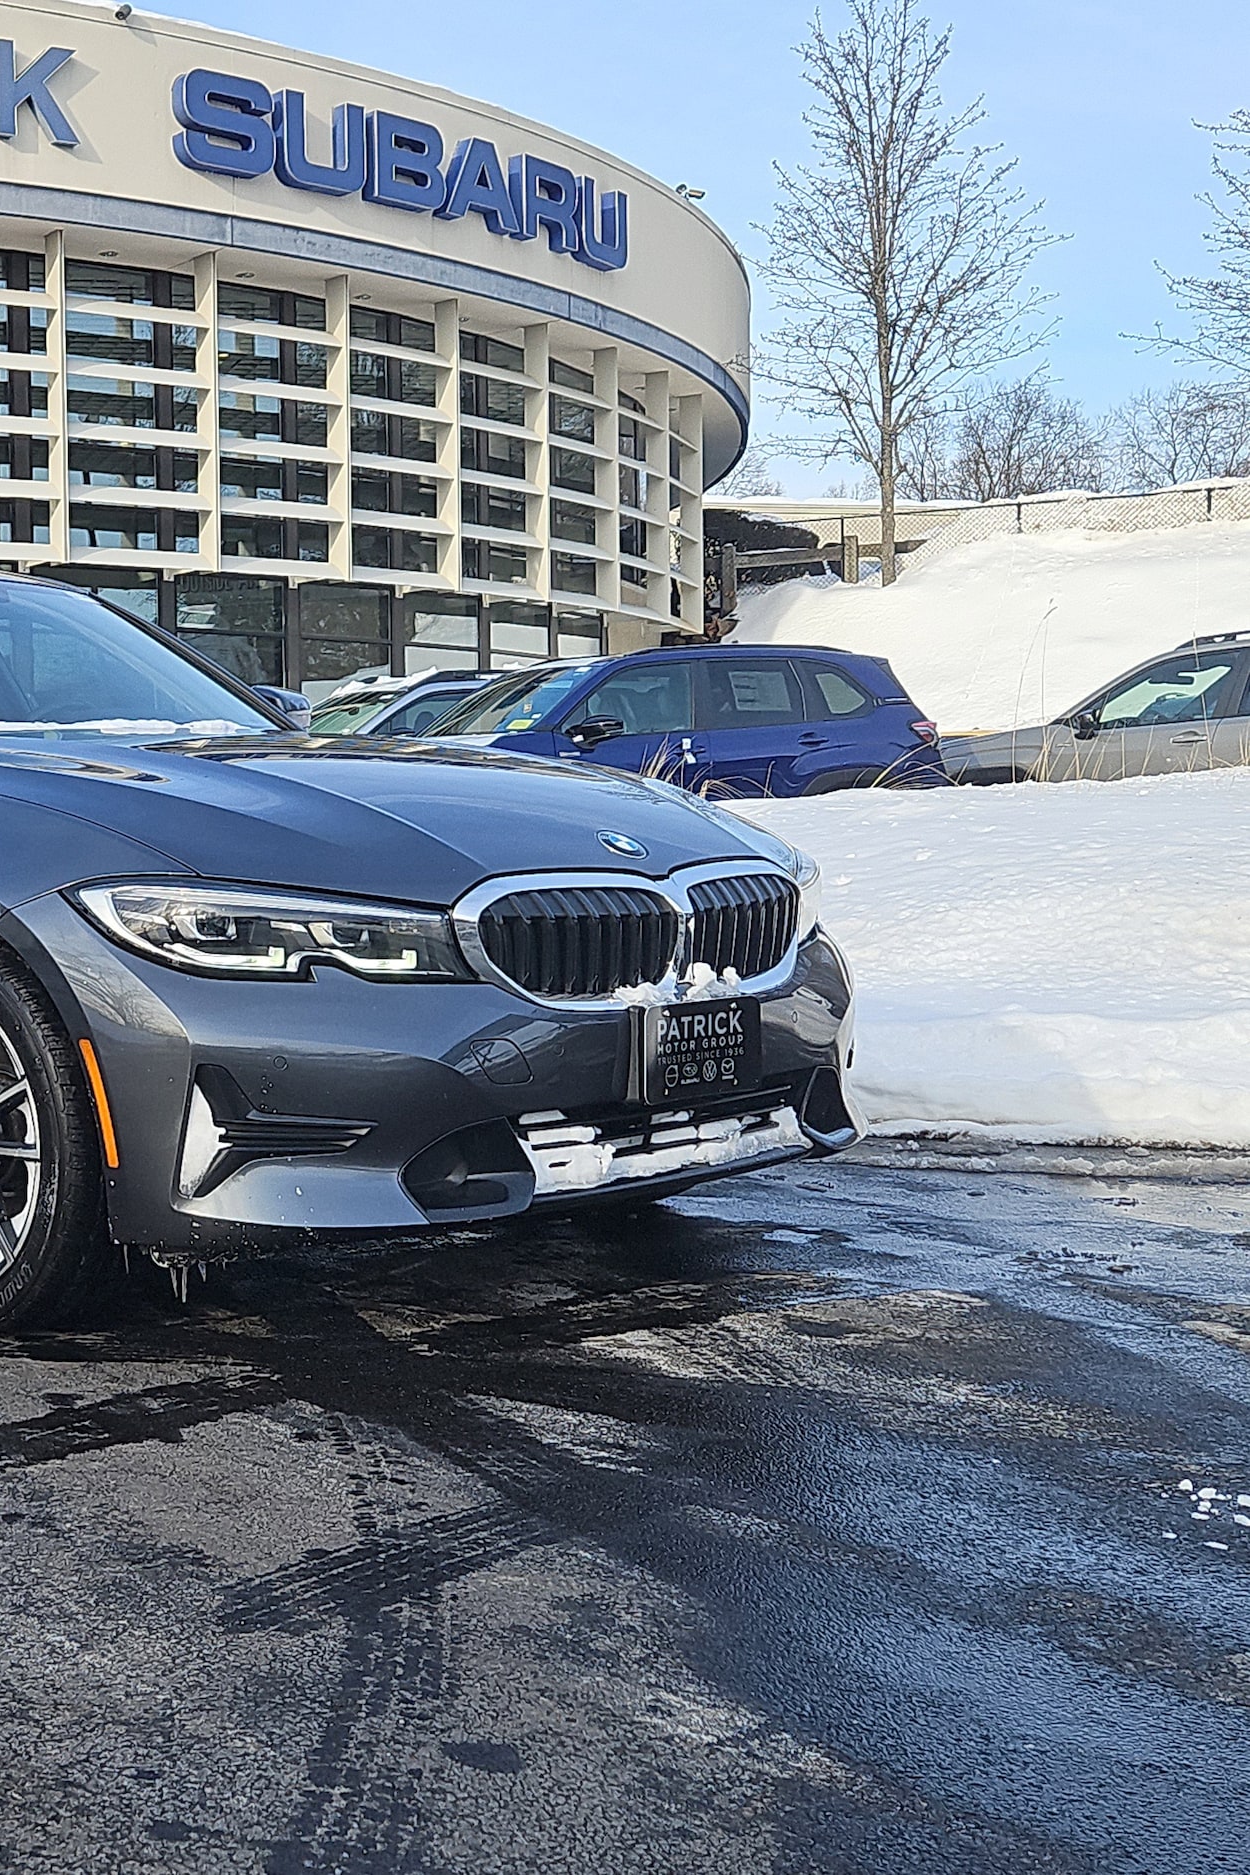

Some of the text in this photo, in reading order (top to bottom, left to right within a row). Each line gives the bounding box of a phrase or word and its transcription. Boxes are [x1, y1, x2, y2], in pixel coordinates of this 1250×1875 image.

[171, 67, 628, 272] SUBARU
[657, 1009, 744, 1043] PATRICK
[657, 1034, 744, 1055] MOTOR GROUP
[657, 1047, 745, 1066] TRUSTED SINCE 1936
